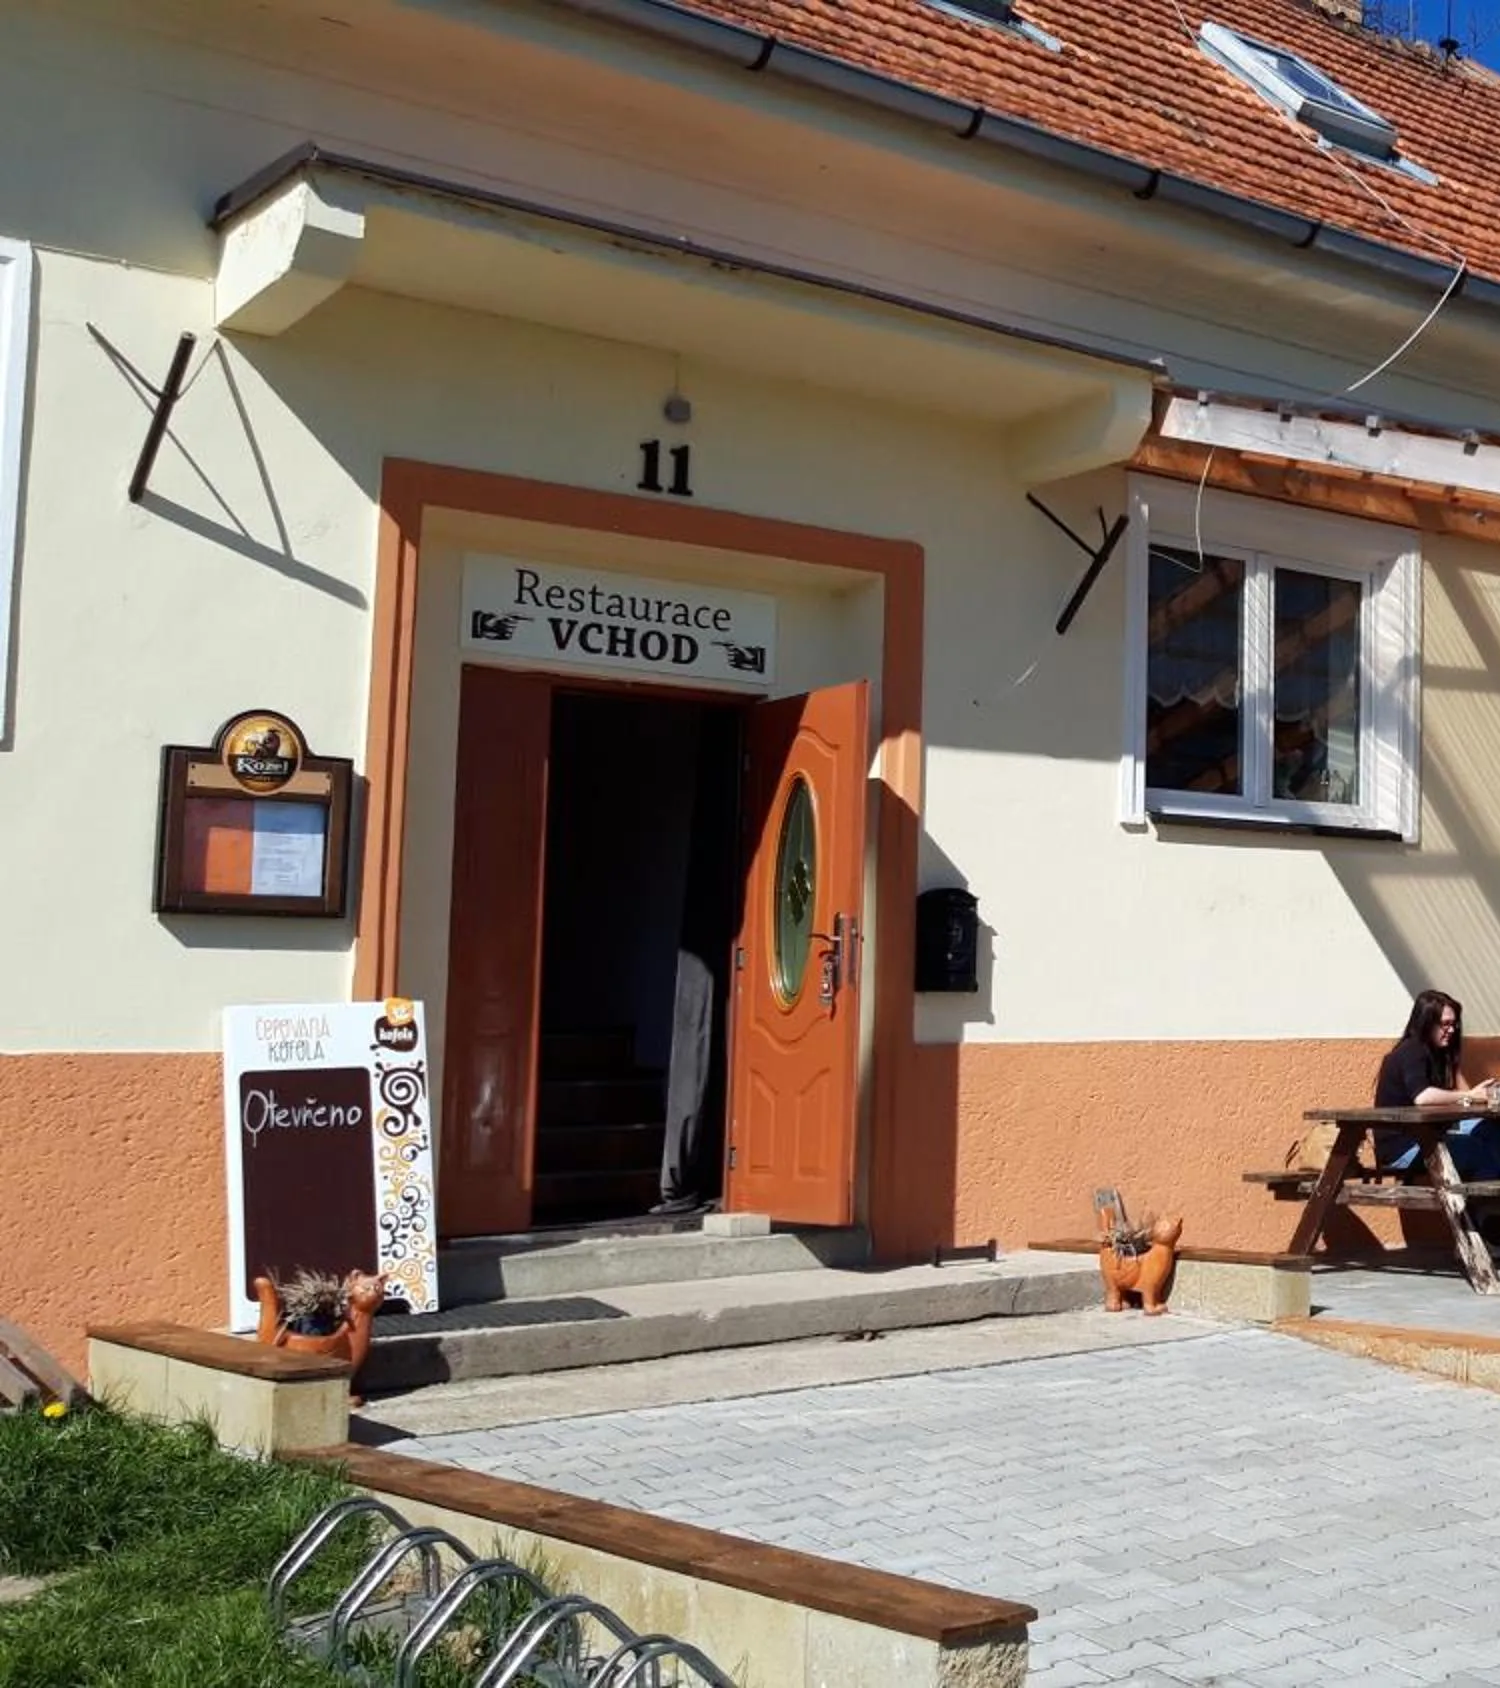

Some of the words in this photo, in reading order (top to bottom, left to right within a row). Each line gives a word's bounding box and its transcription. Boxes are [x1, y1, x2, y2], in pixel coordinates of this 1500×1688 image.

[637, 439, 693, 497] 11
[513, 568, 731, 632] Restaurace
[548, 617, 699, 665] VCHOD
[267, 1040, 325, 1064] KOFOLA
[243, 1089, 363, 1148] Otevřeno
